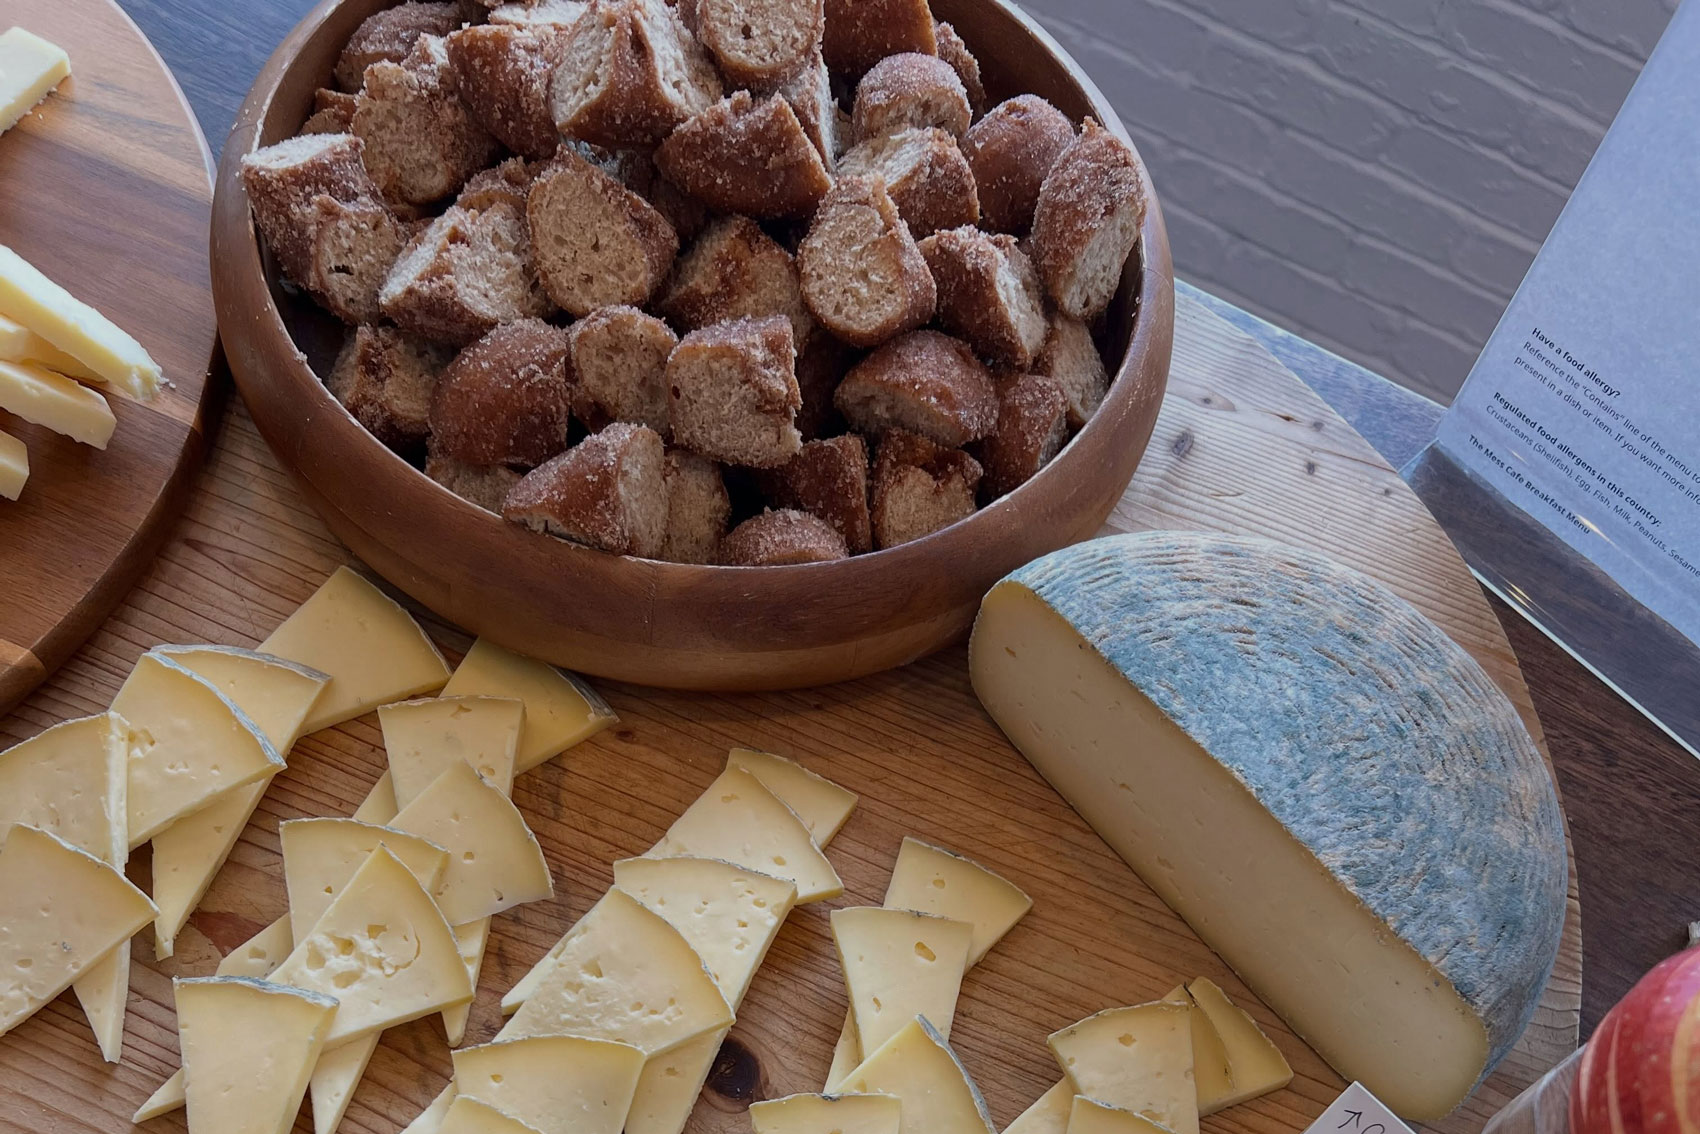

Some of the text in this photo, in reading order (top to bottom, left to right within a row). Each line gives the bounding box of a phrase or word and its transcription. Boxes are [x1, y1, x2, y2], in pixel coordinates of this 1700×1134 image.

[1514, 356, 1548, 387] present
[1548, 381, 1556, 391] in
[1557, 389, 1562, 397] a
[1564, 394, 1582, 412] dish
[1582, 407, 1593, 417] or
[1592, 414, 1613, 437] item.
[1614, 432, 1622, 445] If
[1620, 441, 1639, 456] you
[1640, 452, 1661, 474] want
[1661, 470, 1684, 491] more
[1524, 341, 1564, 376] Reference
[1566, 373, 1580, 389] the
[1624, 419, 1639, 435] line
[1641, 432, 1652, 444] of
[1650, 440, 1666, 455] the
[1666, 453, 1691, 476] menu
[1532, 328, 1554, 349] Have
[1562, 351, 1584, 371] food
[1584, 370, 1620, 398] allergy?
[1469, 434, 1590, 534] The Mess Cafe Breakfast Menu
[1486, 405, 1533, 446] Crustaceans
[1574, 474, 1592, 493] Egg,
[1593, 490, 1611, 508] Fish,
[1613, 504, 1631, 524] Milk,
[1633, 520, 1666, 552] Peanuts,
[1668, 549, 1700, 578] Sesame
[1494, 392, 1662, 528] Regulated food allergens in this country:
